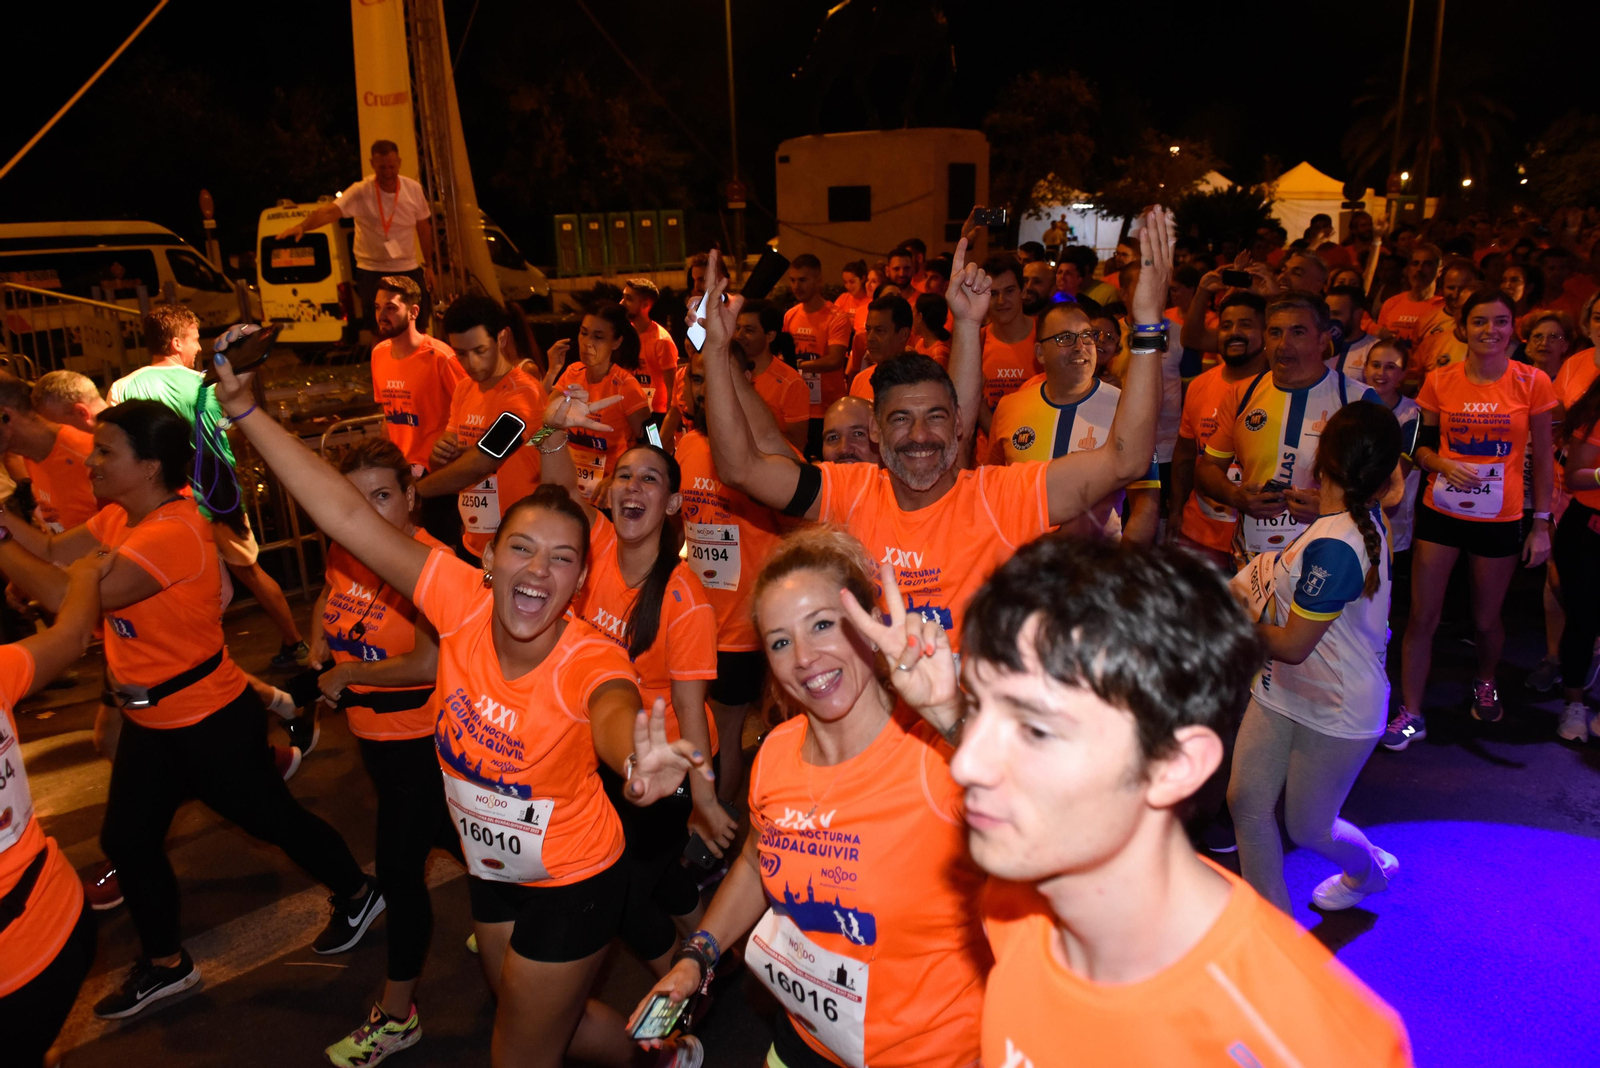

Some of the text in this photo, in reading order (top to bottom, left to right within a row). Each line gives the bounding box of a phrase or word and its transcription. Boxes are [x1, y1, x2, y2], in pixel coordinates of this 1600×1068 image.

[997, 368, 1024, 378] XXXV
[1462, 402, 1498, 412] XXXV
[692, 477, 722, 490] XXXV
[462, 494, 488, 508] 22504
[692, 545, 729, 562] 20194
[881, 546, 924, 569] XXXV
[900, 568, 942, 578] NOCTURNA
[456, 688, 526, 750] CARRERA NOCTURNA
[474, 694, 518, 732] XXXV
[450, 701, 524, 762] GUADALQUIVIR
[460, 818, 522, 855] 16010
[761, 834, 860, 862] GUADALQUIVIR
[764, 962, 838, 1022] 16016
